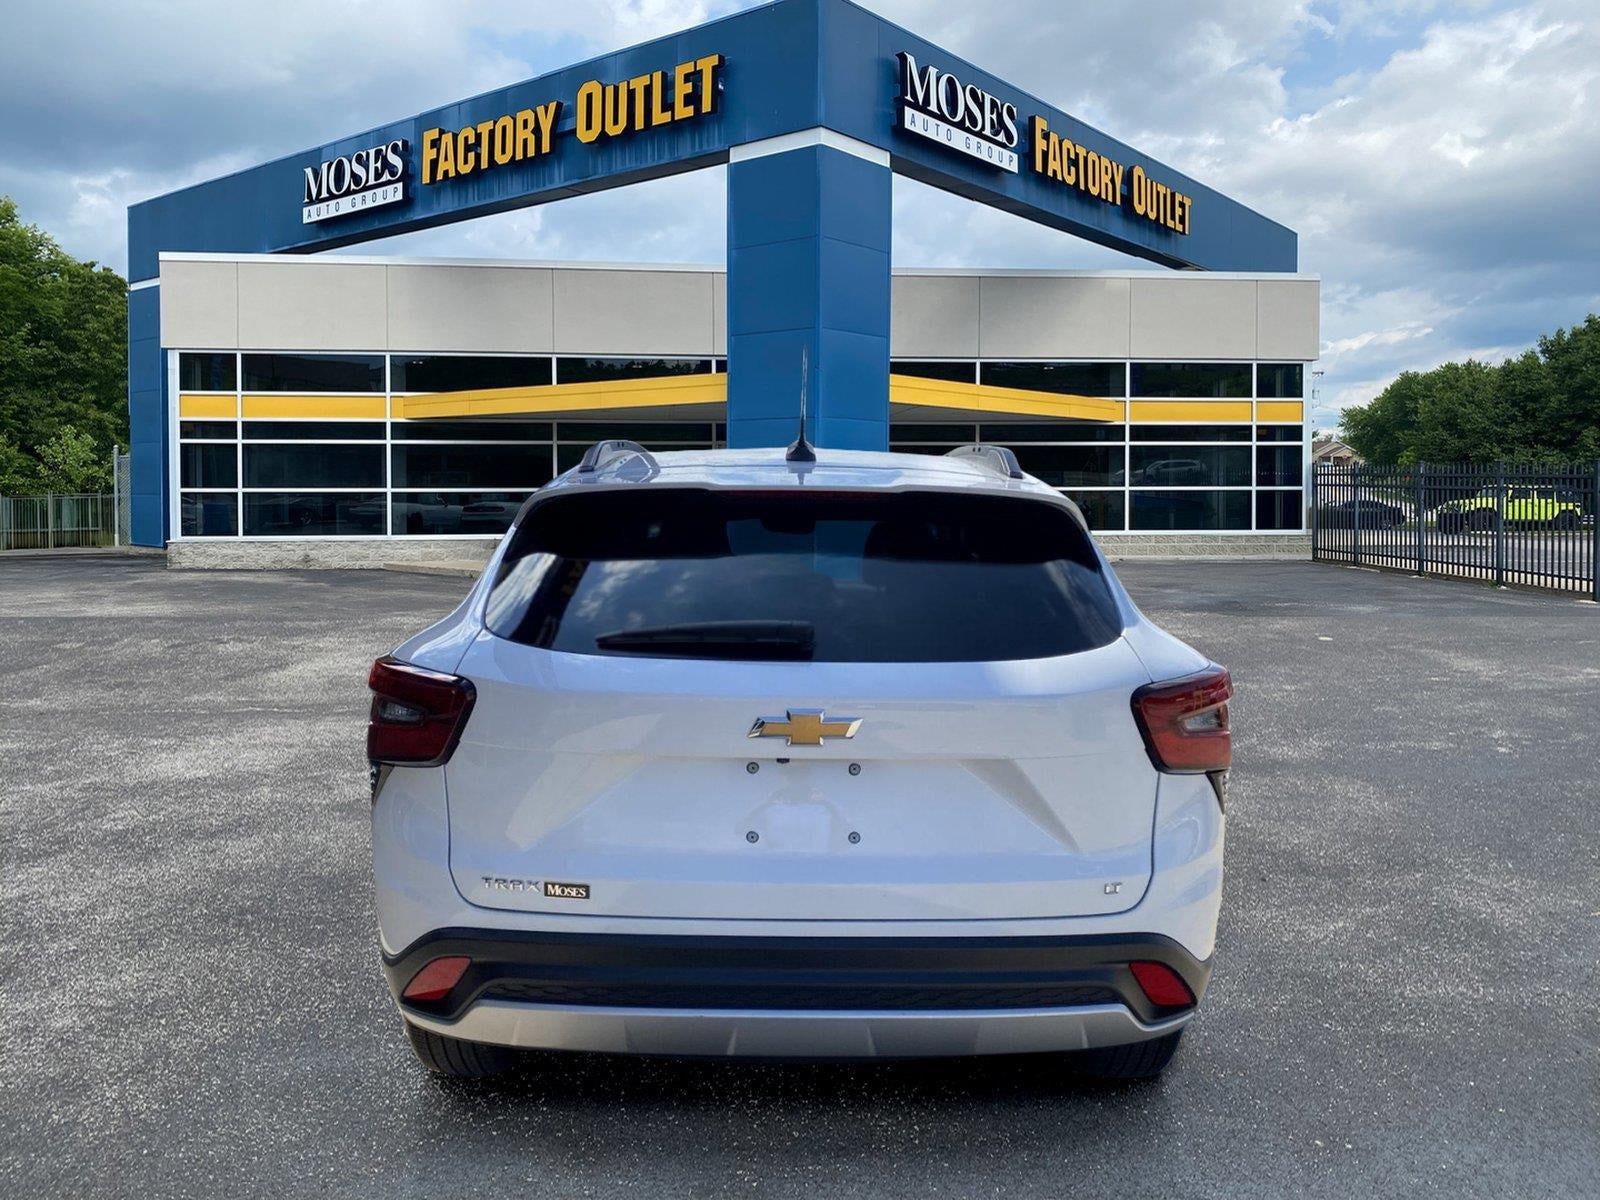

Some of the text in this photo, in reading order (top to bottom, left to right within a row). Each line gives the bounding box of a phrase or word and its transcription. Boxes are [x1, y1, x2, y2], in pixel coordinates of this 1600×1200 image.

[421, 54, 722, 185] FACTORY OUTLET
[904, 52, 1019, 148] MOSES
[909, 112, 1015, 166] AUTO GROUP
[303, 139, 404, 203] MOSES
[1033, 115, 1192, 235] FACTORY OUTLET
[306, 186, 400, 220] AUTO GROUP
[481, 876, 541, 893] TRAX
[546, 883, 587, 898] MOSES
[1104, 882, 1123, 895] LT
